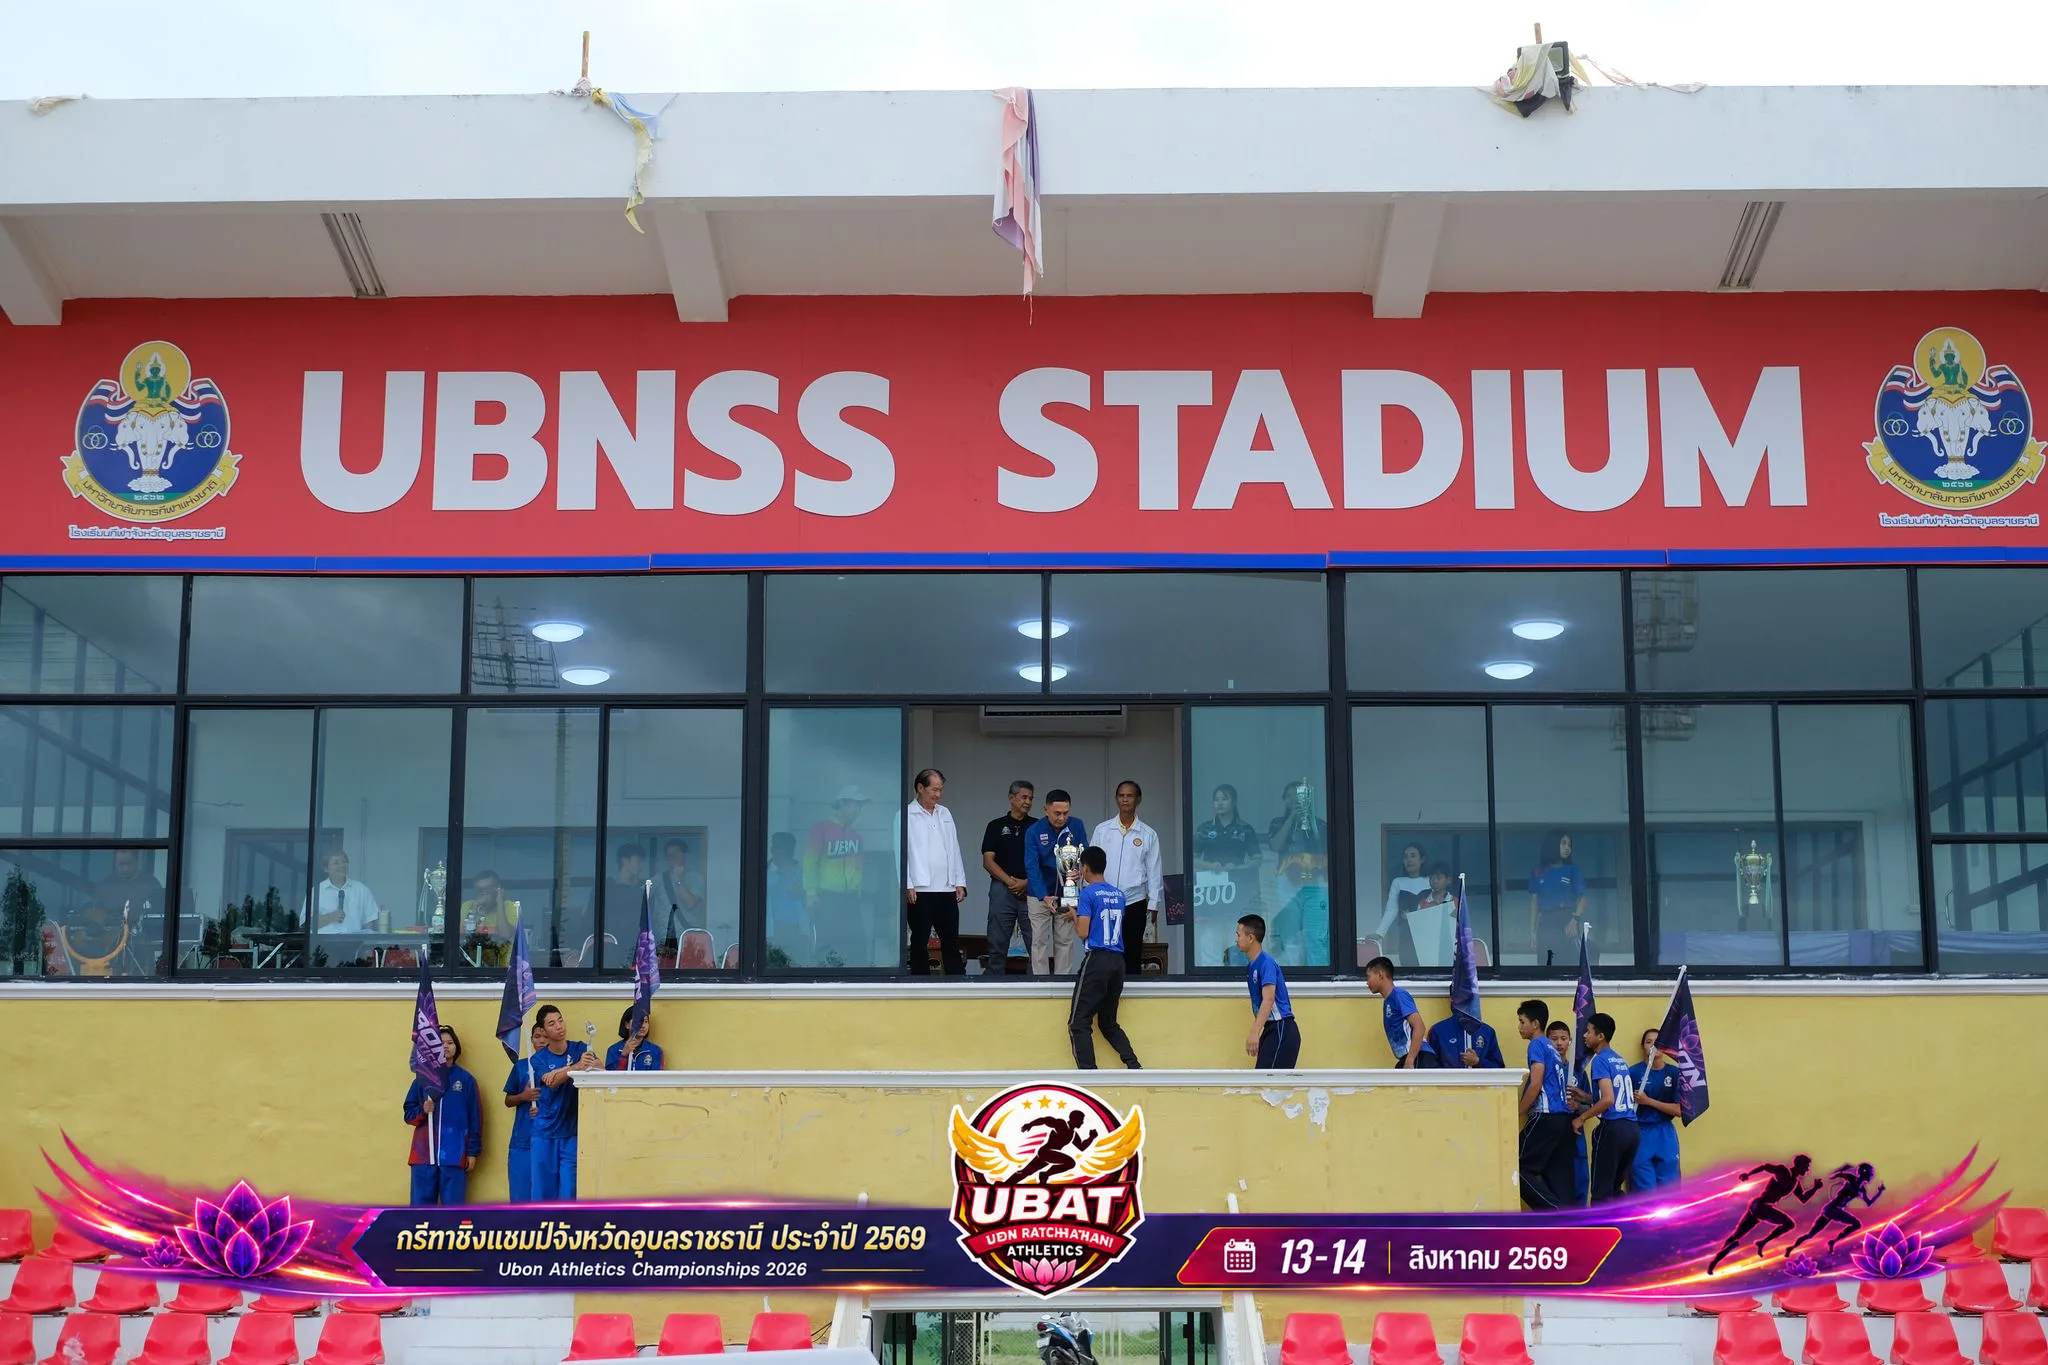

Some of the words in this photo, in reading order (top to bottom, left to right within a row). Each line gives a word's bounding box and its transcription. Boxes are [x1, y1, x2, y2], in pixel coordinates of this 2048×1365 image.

[299, 369, 896, 518] UBNSS
[997, 366, 1809, 514] STADIUM
[1100, 908, 1123, 946] 17
[1613, 1074, 1635, 1113] 20
